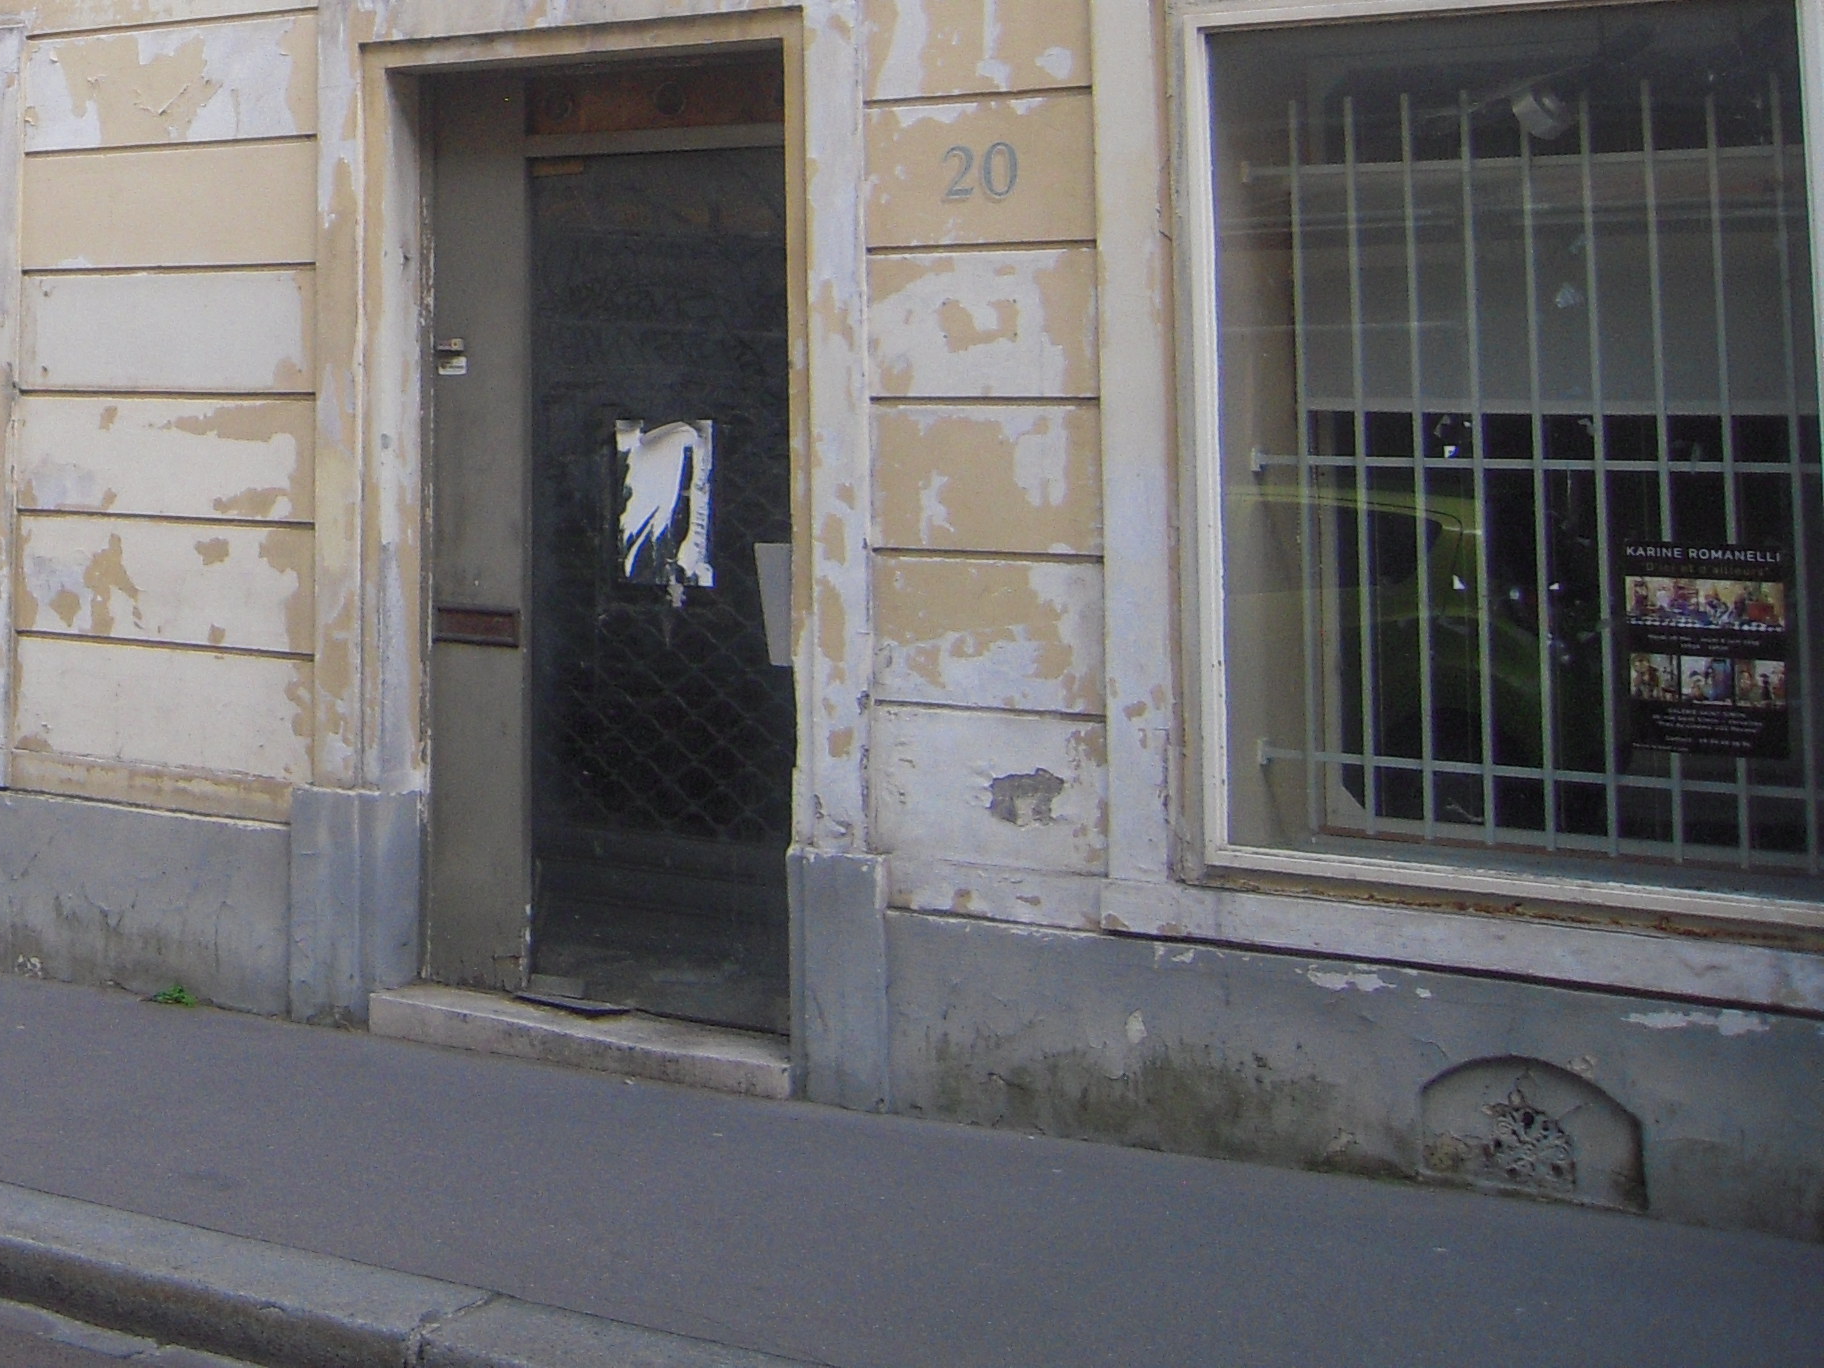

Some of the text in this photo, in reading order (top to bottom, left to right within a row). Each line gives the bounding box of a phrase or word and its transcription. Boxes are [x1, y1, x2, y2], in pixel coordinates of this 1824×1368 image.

[941, 141, 1019, 198] 20
[1626, 546, 1781, 562] KARINE ROMANELLI
